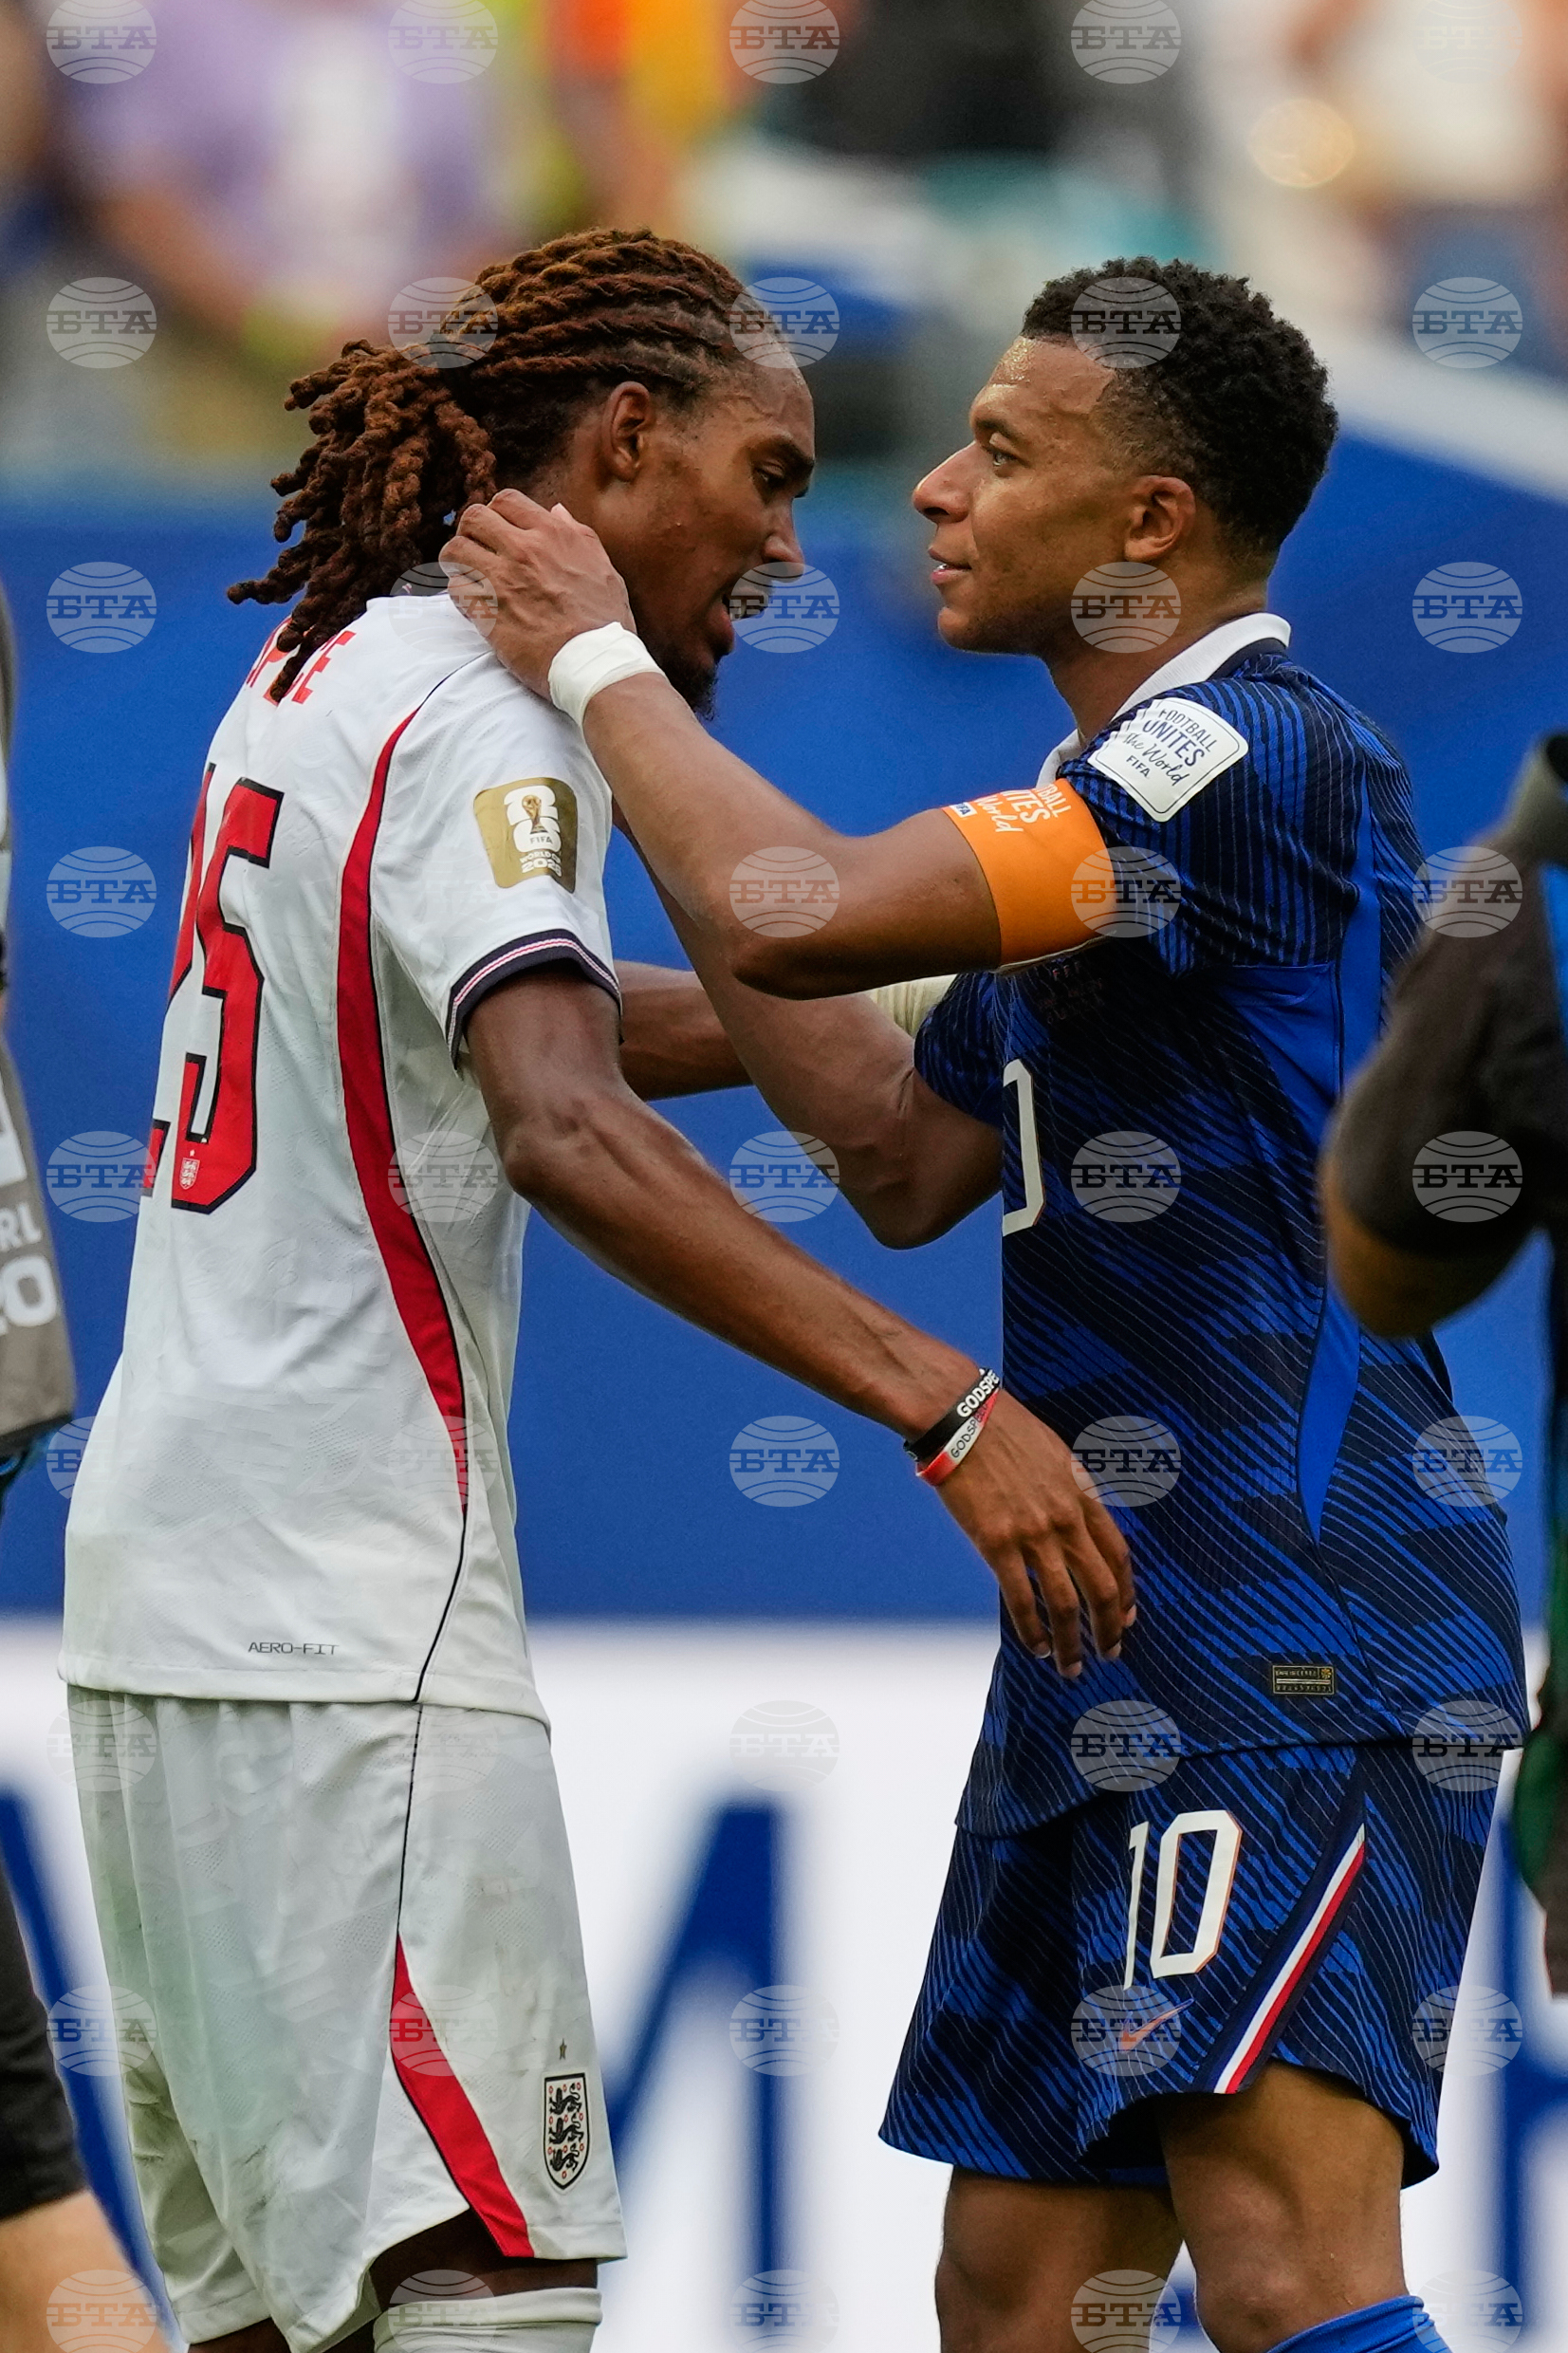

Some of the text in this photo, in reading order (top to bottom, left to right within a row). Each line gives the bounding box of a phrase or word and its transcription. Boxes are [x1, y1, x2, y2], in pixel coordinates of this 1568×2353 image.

[1143, 719, 1205, 767] UNITES
[1159, 708, 1217, 752] FOOTBALL
[1126, 754, 1152, 778] FIFA
[1142, 741, 1190, 787] World
[519, 850, 552, 863] WORLD
[529, 836, 554, 845] FIFA
[248, 1641, 340, 1656] AERO-FIT
[1123, 1809, 1243, 1991] 10
